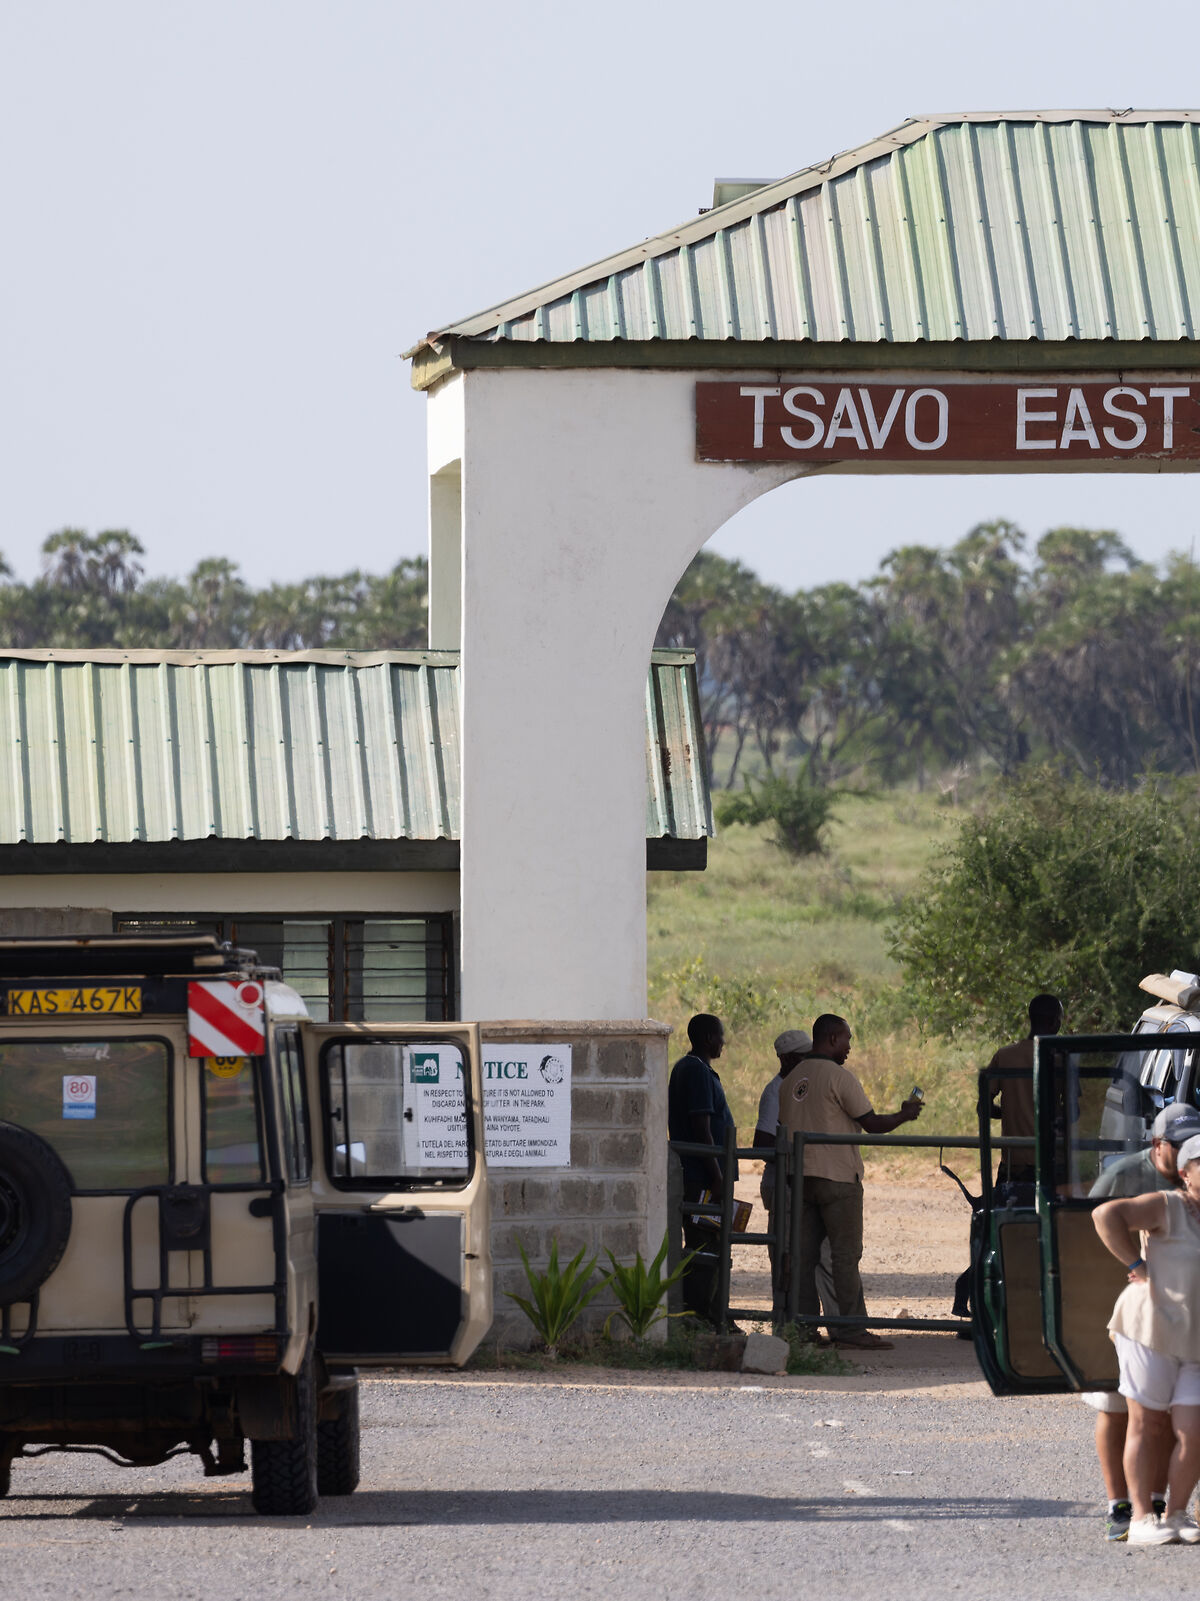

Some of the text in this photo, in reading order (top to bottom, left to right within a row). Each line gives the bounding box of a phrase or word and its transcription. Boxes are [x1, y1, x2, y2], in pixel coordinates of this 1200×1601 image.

[739, 386, 950, 451] TSAVO
[1015, 386, 1190, 451] EAST
[10, 988, 139, 1015] KAS 467K
[455, 1061, 528, 1079] NTICE
[70, 1081, 89, 1094] 80
[431, 1089, 455, 1097] RESPECT
[503, 1089, 509, 1097] IS
[510, 1089, 520, 1097] NOT
[521, 1089, 546, 1097] ALLOWED
[422, 1140, 443, 1148] TUTELA
[444, 1140, 454, 1148] DEL
[455, 1140, 469, 1148] PARC
[485, 1139, 502, 1147] ETATO
[503, 1139, 526, 1147] BUTTARE
[437, 1150, 463, 1158] RISPETTO
